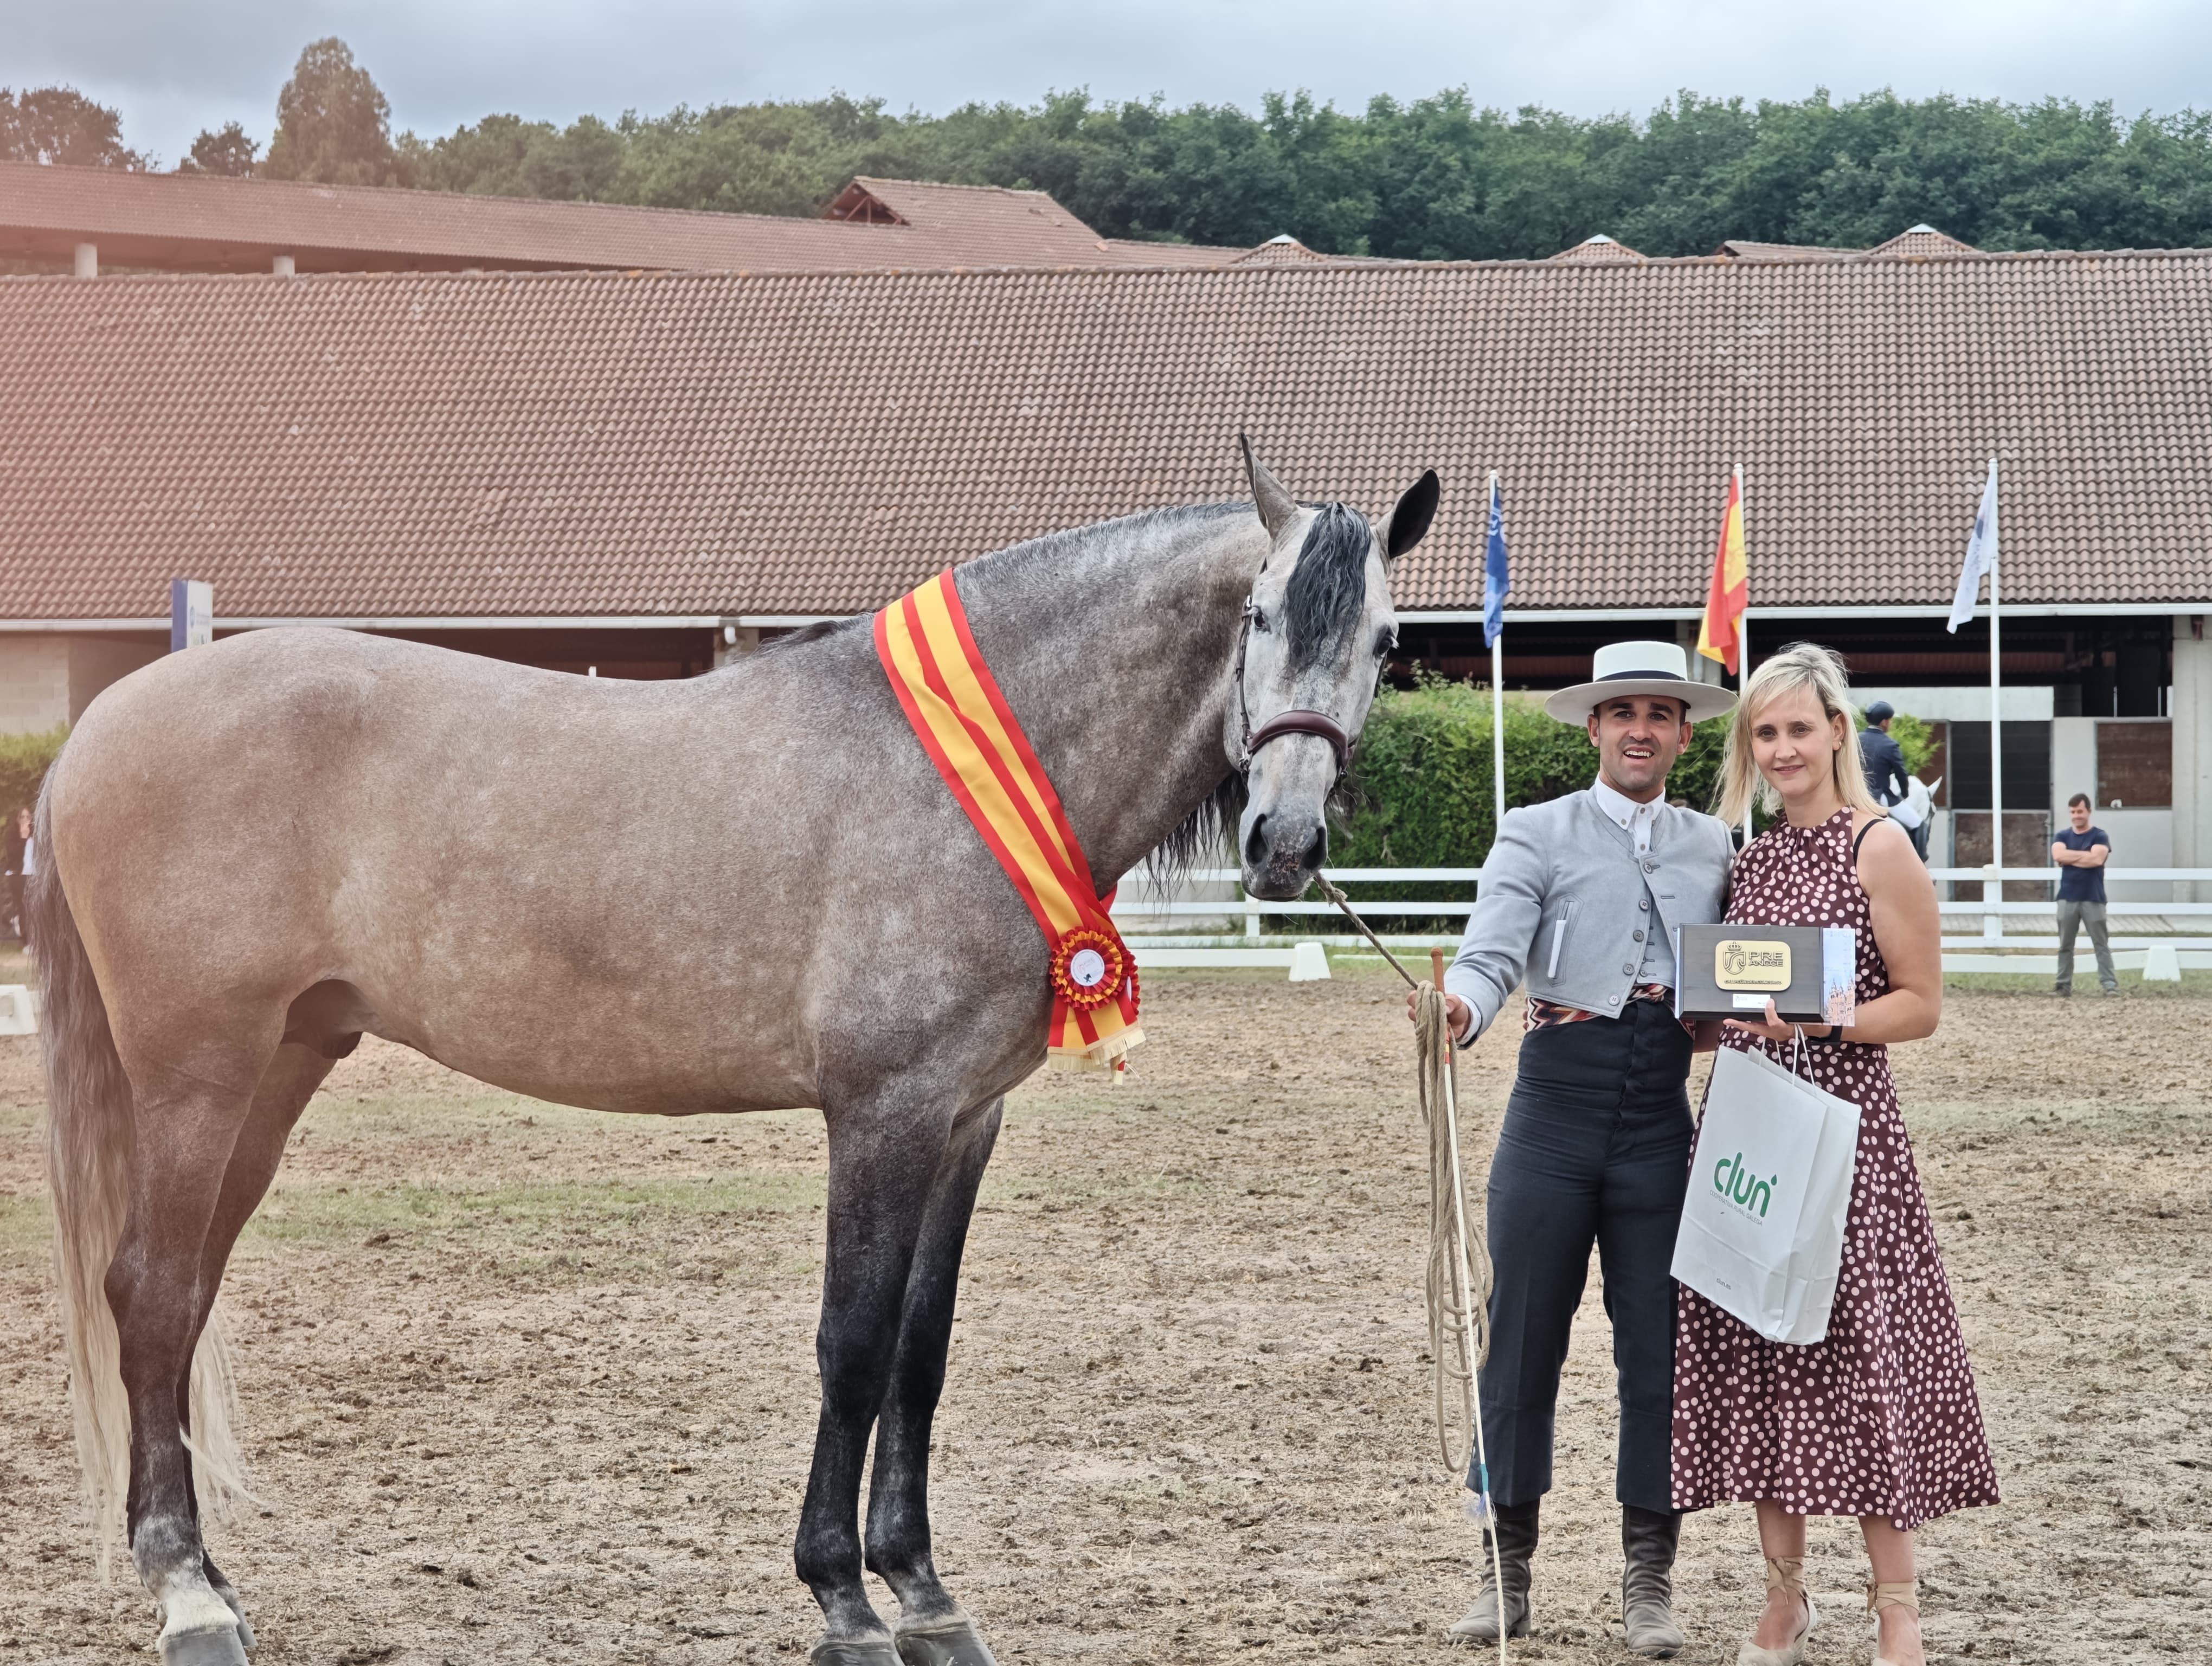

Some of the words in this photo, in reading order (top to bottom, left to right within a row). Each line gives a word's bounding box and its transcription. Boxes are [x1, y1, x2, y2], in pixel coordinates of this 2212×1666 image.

[1748, 951, 1783, 960] PRE
[1714, 1152, 1771, 1218] clun
[1733, 1205, 1745, 1216] RURAL
[1745, 1213, 1763, 1227] GALEGA
